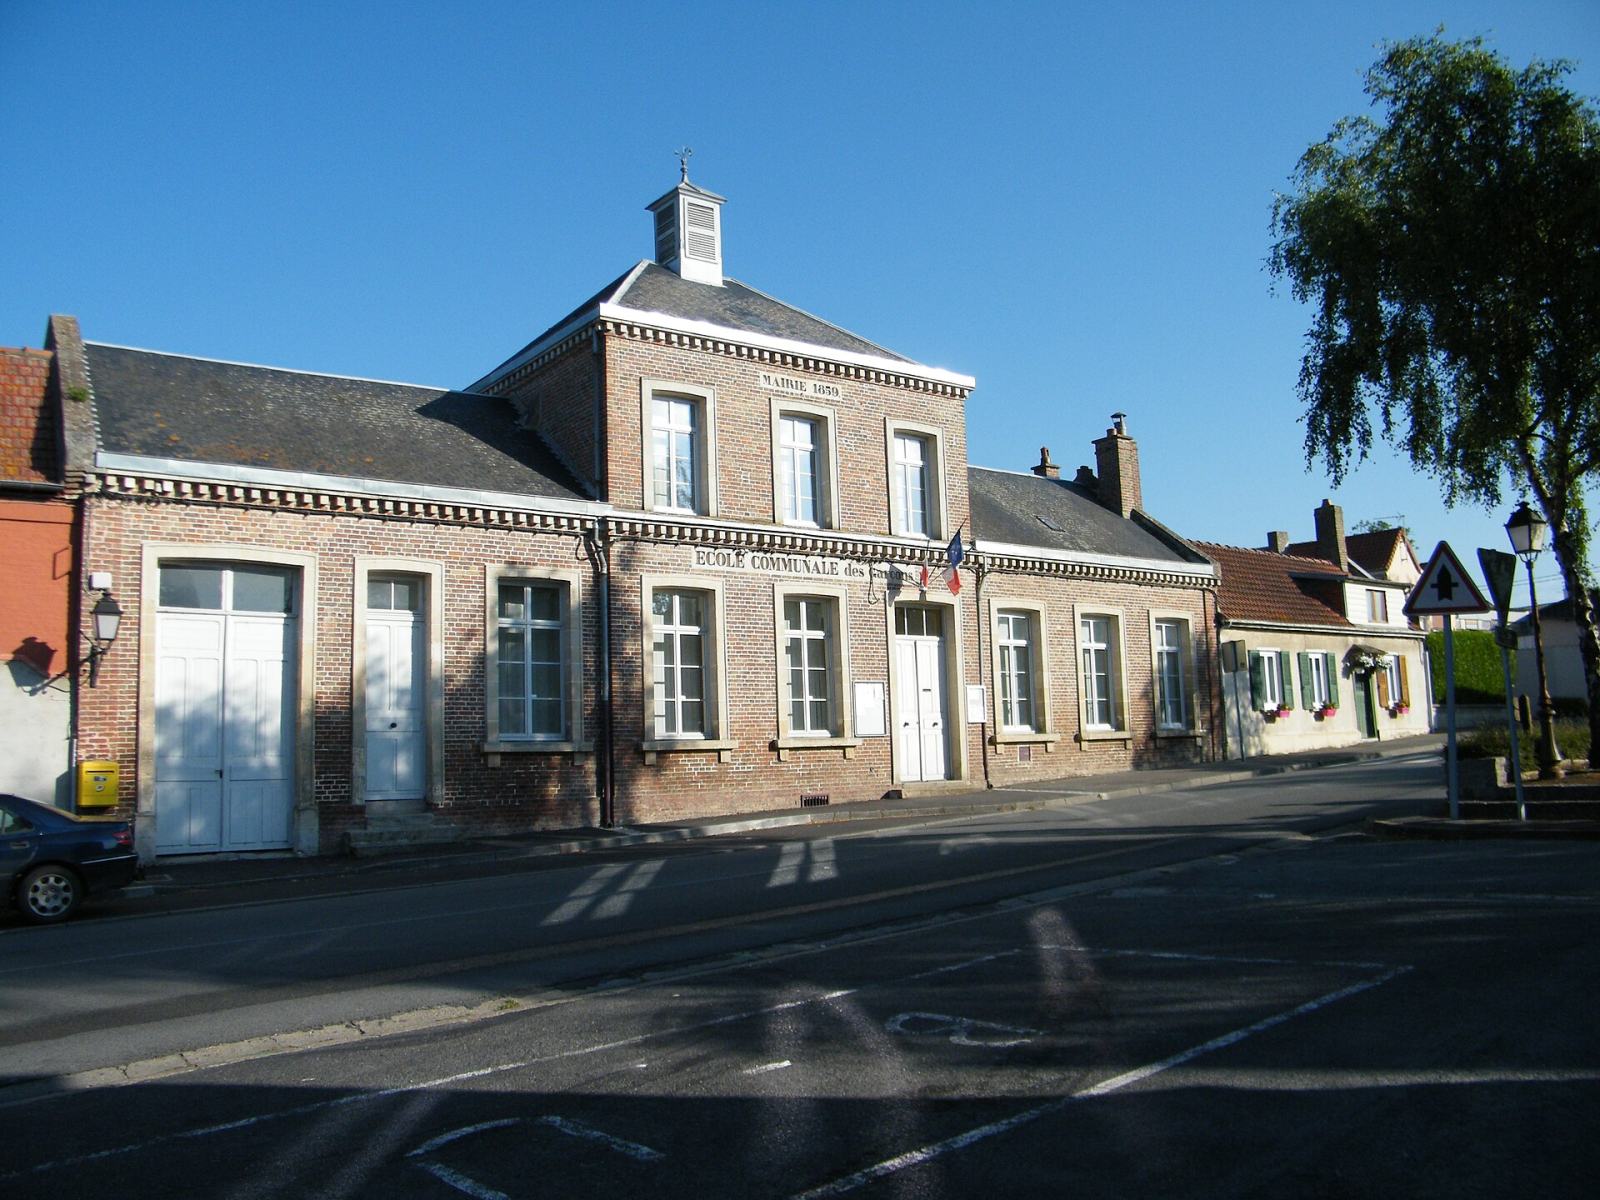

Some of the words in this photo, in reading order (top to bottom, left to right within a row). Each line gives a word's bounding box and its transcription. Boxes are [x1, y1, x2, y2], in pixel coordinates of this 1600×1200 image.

[762, 374, 807, 392] MAIRIE
[813, 383, 840, 398] 1859
[695, 550, 745, 569] ECOLE
[751, 555, 839, 576] COMMUNALE
[844, 563, 865, 577] des
